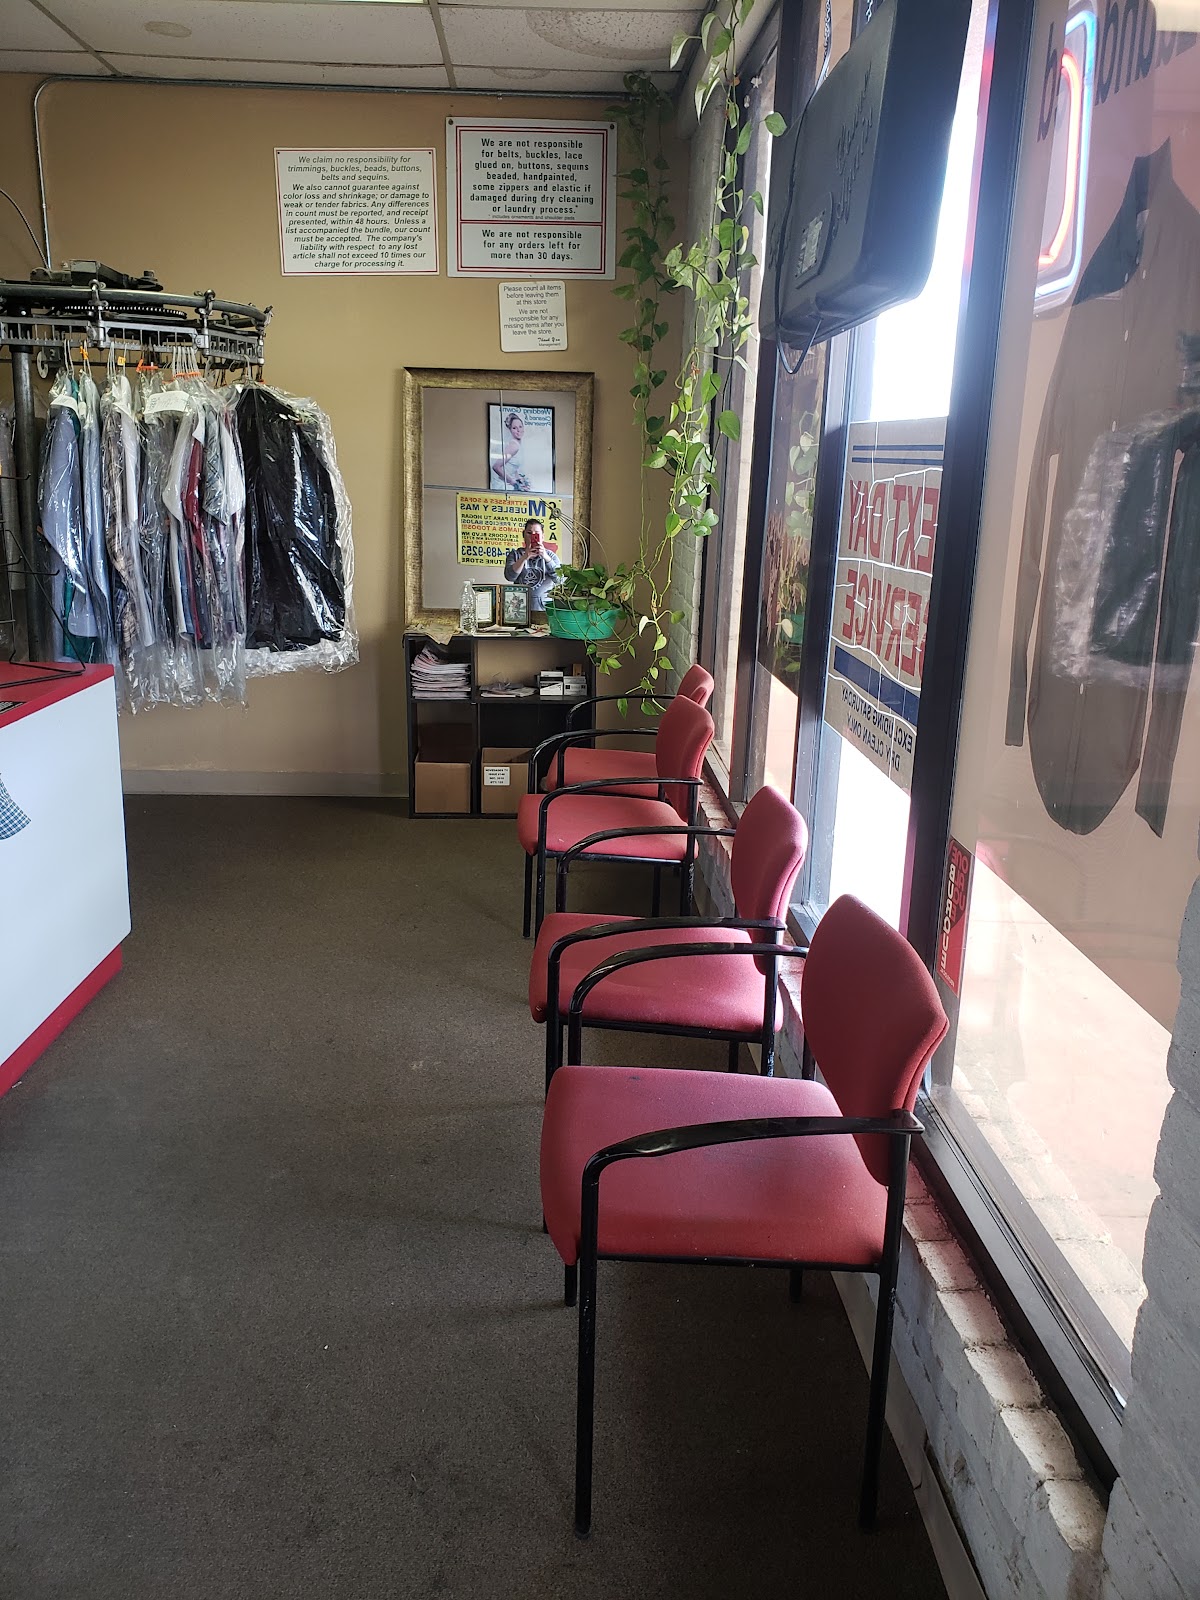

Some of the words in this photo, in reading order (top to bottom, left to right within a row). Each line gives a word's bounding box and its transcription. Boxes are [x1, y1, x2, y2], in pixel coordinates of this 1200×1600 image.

[481, 138, 495, 147] We
[498, 139, 512, 147] are
[516, 140, 530, 148] not
[534, 140, 583, 149] responsible
[481, 150, 494, 158] for
[497, 150, 522, 159] belts,
[525, 150, 561, 160] buckles,
[565, 151, 583, 159] lace
[346, 156, 398, 165] responsibility
[288, 165, 328, 173] trimmings,
[330, 165, 362, 173] buckles,
[363, 165, 389, 173] beads,
[391, 165, 422, 173] buttons,
[475, 161, 497, 170] glued
[501, 162, 514, 170] on,
[517, 161, 553, 171] buttons,
[556, 163, 589, 172] sequins
[358, 174, 390, 182] sequins.
[486, 172, 520, 181] beaded,
[523, 172, 577, 183] handpainted,
[351, 184, 390, 193] guarantee
[391, 184, 420, 192] against
[498, 183, 529, 192] zippers
[552, 184, 580, 192] elastic
[585, 184, 591, 192] if
[338, 192, 378, 200] shrinkage;
[390, 192, 420, 200] damage
[470, 194, 507, 203] damaged
[511, 194, 537, 204] during
[540, 195, 554, 204] dry
[558, 195, 594, 205] cleaning
[371, 201, 385, 209] Any
[504, 205, 536, 214] laundry
[350, 209, 384, 218] reported,
[402, 209, 429, 217] receipt
[288, 219, 329, 227] presented,
[299, 227, 349, 235] accompanied
[482, 229, 495, 238] We
[533, 231, 582, 240] responsible
[326, 235, 362, 243] accepted.
[382, 235, 423, 243] company's
[300, 244, 327, 252] liability
[346, 244, 375, 252] respect
[483, 240, 495, 248] for
[518, 241, 545, 249] orders
[549, 241, 564, 249] left
[568, 242, 580, 250] for
[515, 252, 534, 260] than
[537, 252, 548, 260] 30
[551, 252, 573, 261] days.
[314, 261, 340, 269] charge
[354, 261, 396, 269] processing
